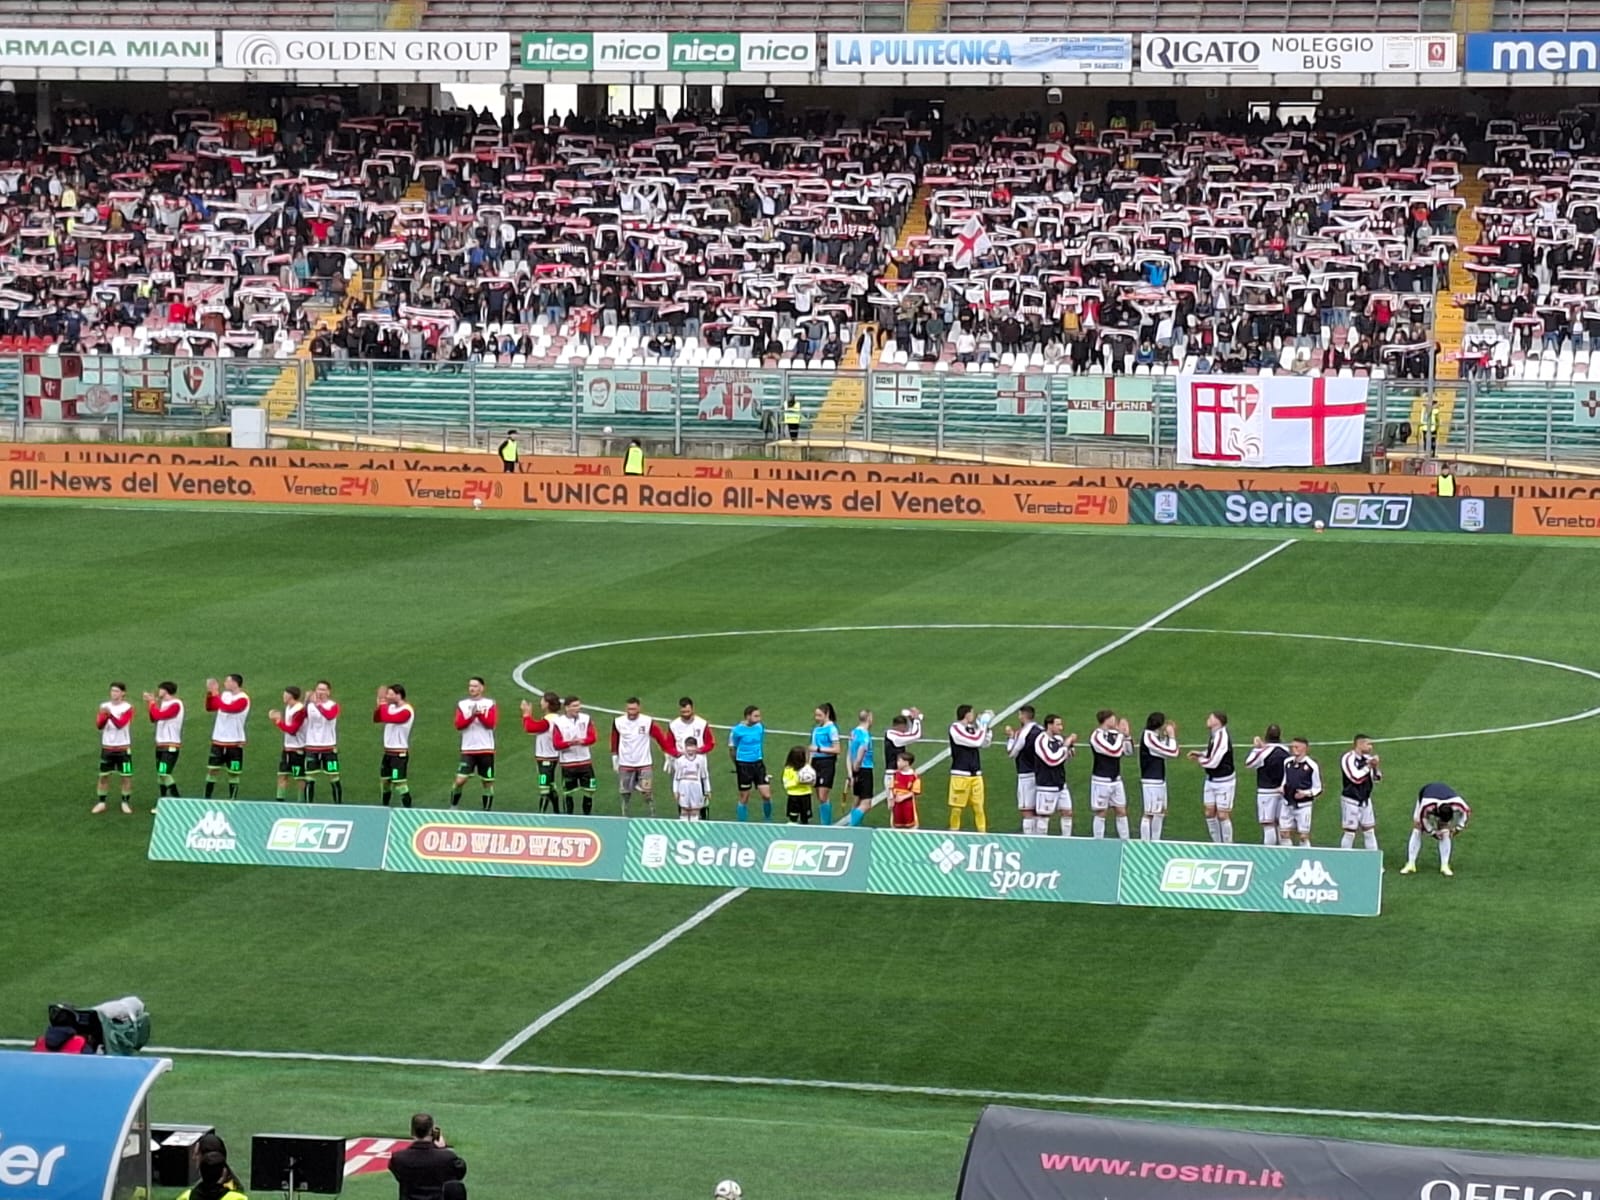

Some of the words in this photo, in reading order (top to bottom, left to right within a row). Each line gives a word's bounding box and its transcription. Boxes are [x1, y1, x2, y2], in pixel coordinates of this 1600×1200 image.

[0, 40, 117, 57] RMACIA
[127, 40, 210, 58] MIANI
[286, 40, 397, 61] GOLDEN
[405, 40, 499, 62] GROUP
[526, 37, 589, 62] nico
[600, 38, 662, 61] nico
[672, 38, 736, 62] nico
[747, 39, 809, 61] nico
[834, 40, 861, 66] LA
[869, 39, 1013, 66] PULITECNICA
[1146, 36, 1261, 69] RIGATO
[1271, 37, 1374, 54] NOLEGGIO
[1302, 54, 1342, 70] BUS
[9, 468, 113, 492] All-News
[121, 471, 158, 493] del
[523, 481, 629, 505] L'UNICA
[639, 484, 713, 507] Radio
[723, 486, 833, 511] All-News
[842, 489, 881, 513] del
[1225, 494, 1314, 524] Serie
[1532, 505, 1600, 529] Veneto
[186, 830, 237, 853] Kappa
[423, 830, 468, 853] OLD
[471, 832, 527, 855] WILD
[528, 834, 592, 859] WEST
[674, 839, 757, 869] Serie
[966, 842, 1021, 873] Ifis
[988, 869, 1062, 894] sport
[1282, 880, 1339, 903] Kappa
[0, 1144, 67, 1186] er
[1040, 1151, 1286, 1189] www.rostin.it
